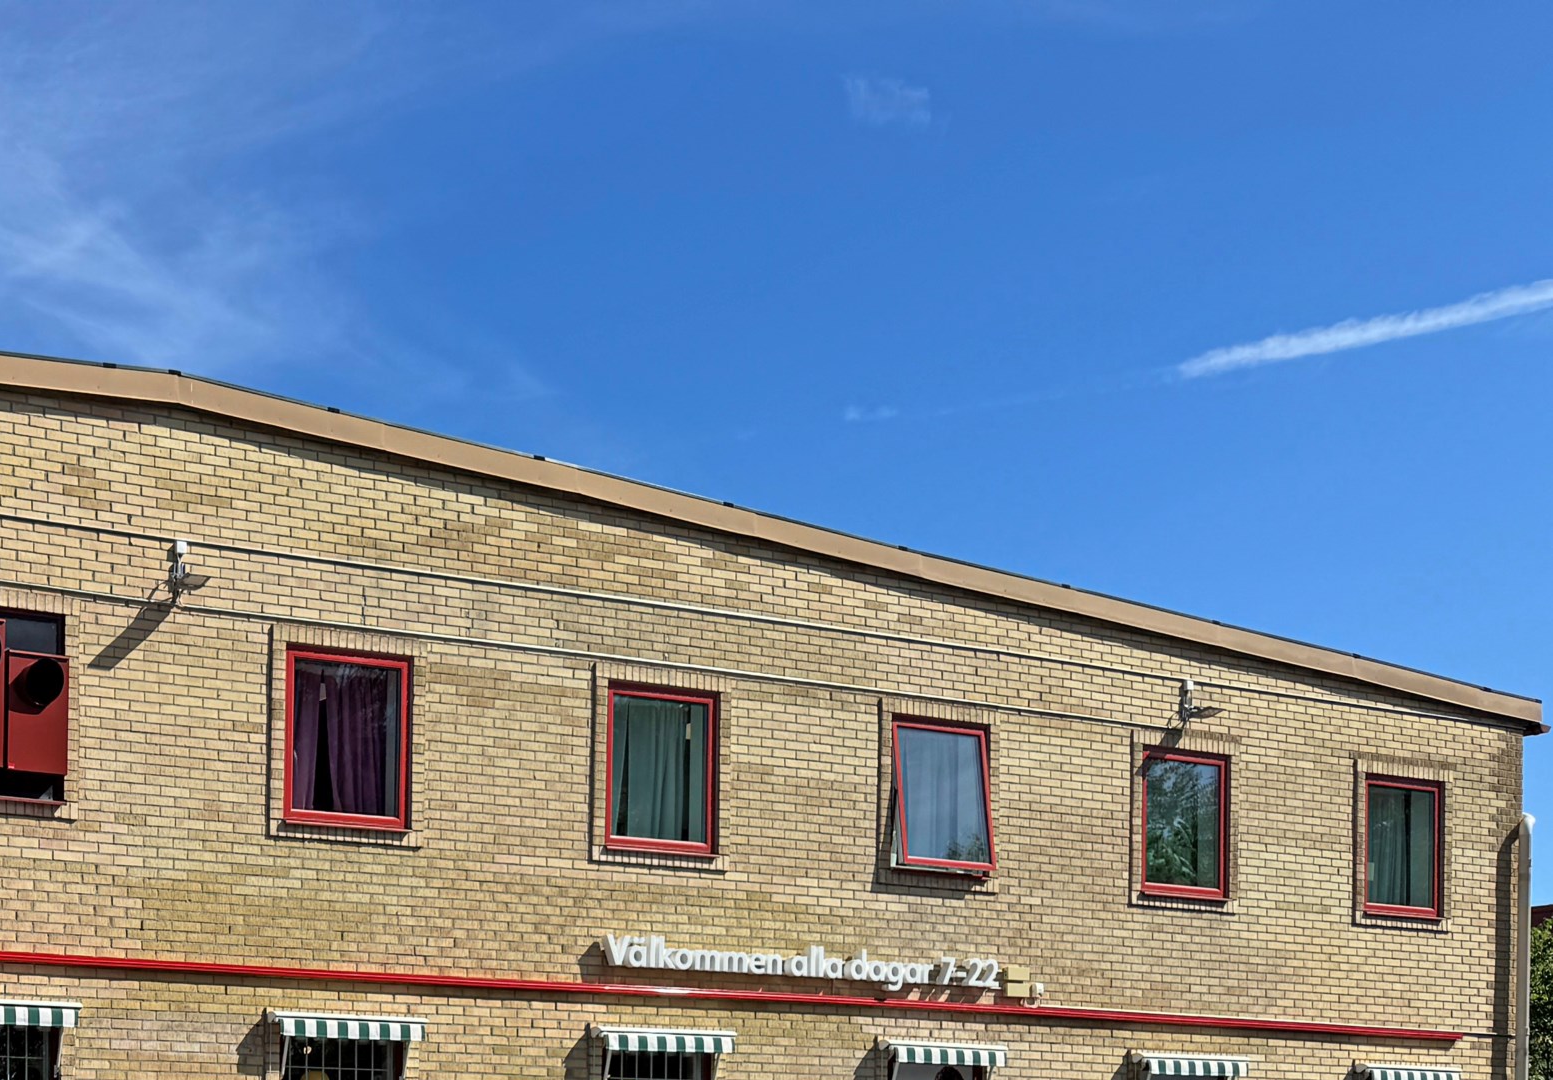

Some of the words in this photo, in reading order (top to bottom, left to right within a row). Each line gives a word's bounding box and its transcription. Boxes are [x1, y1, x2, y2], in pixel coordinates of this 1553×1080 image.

[602, 933, 783, 976] Välkommen
[784, 944, 845, 979] alla
[845, 948, 934, 991] dagar
[936, 957, 1001, 988] 7-22
